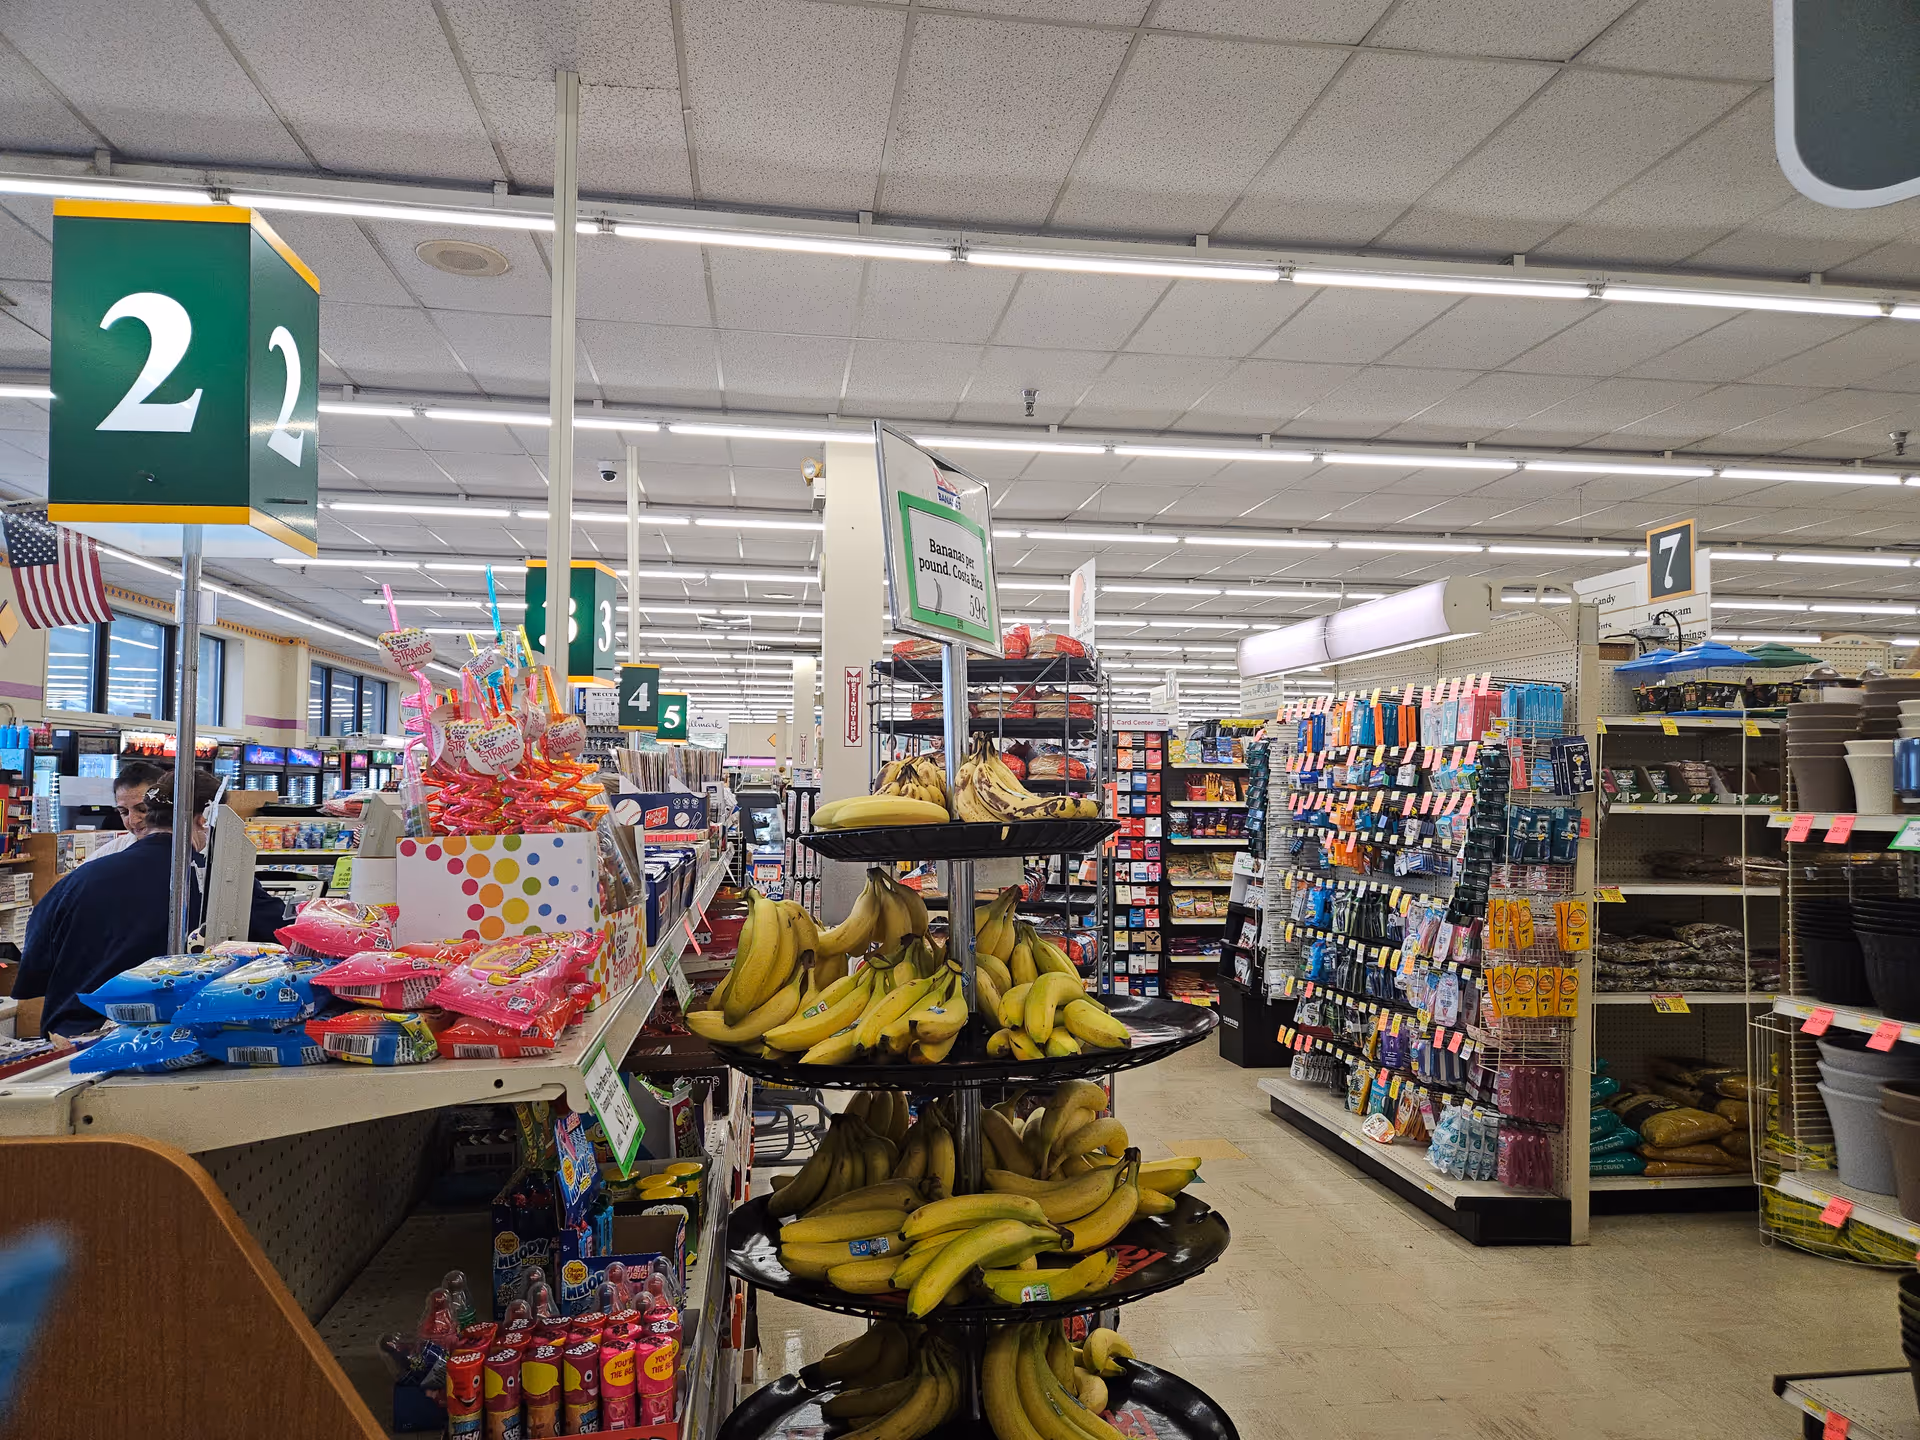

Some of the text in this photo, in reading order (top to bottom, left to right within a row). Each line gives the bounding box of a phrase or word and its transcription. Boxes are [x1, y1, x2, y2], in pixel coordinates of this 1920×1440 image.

[95, 292, 203, 432] 2
[267, 325, 304, 467] 2
[929, 538, 975, 569] Bananas per
[1659, 533, 1682, 589] 7
[919, 557, 984, 591] pound. Costa Rica
[969, 595, 988, 623] 59¢
[1592, 594, 1616, 606] Candy
[598, 600, 612, 652] 3
[392, 641, 432, 670] STRAWS
[628, 683, 651, 711] 4
[664, 705, 681, 729] 5
[478, 736, 498, 747] CRAZY
[478, 738, 521, 771] STRAWS
[497, 1238, 549, 1269] MELODY
[522, 1258, 549, 1266] POPS
[566, 1272, 585, 1280] Chups
[610, 1371, 622, 1380] THE
[652, 1364, 664, 1374] THE
